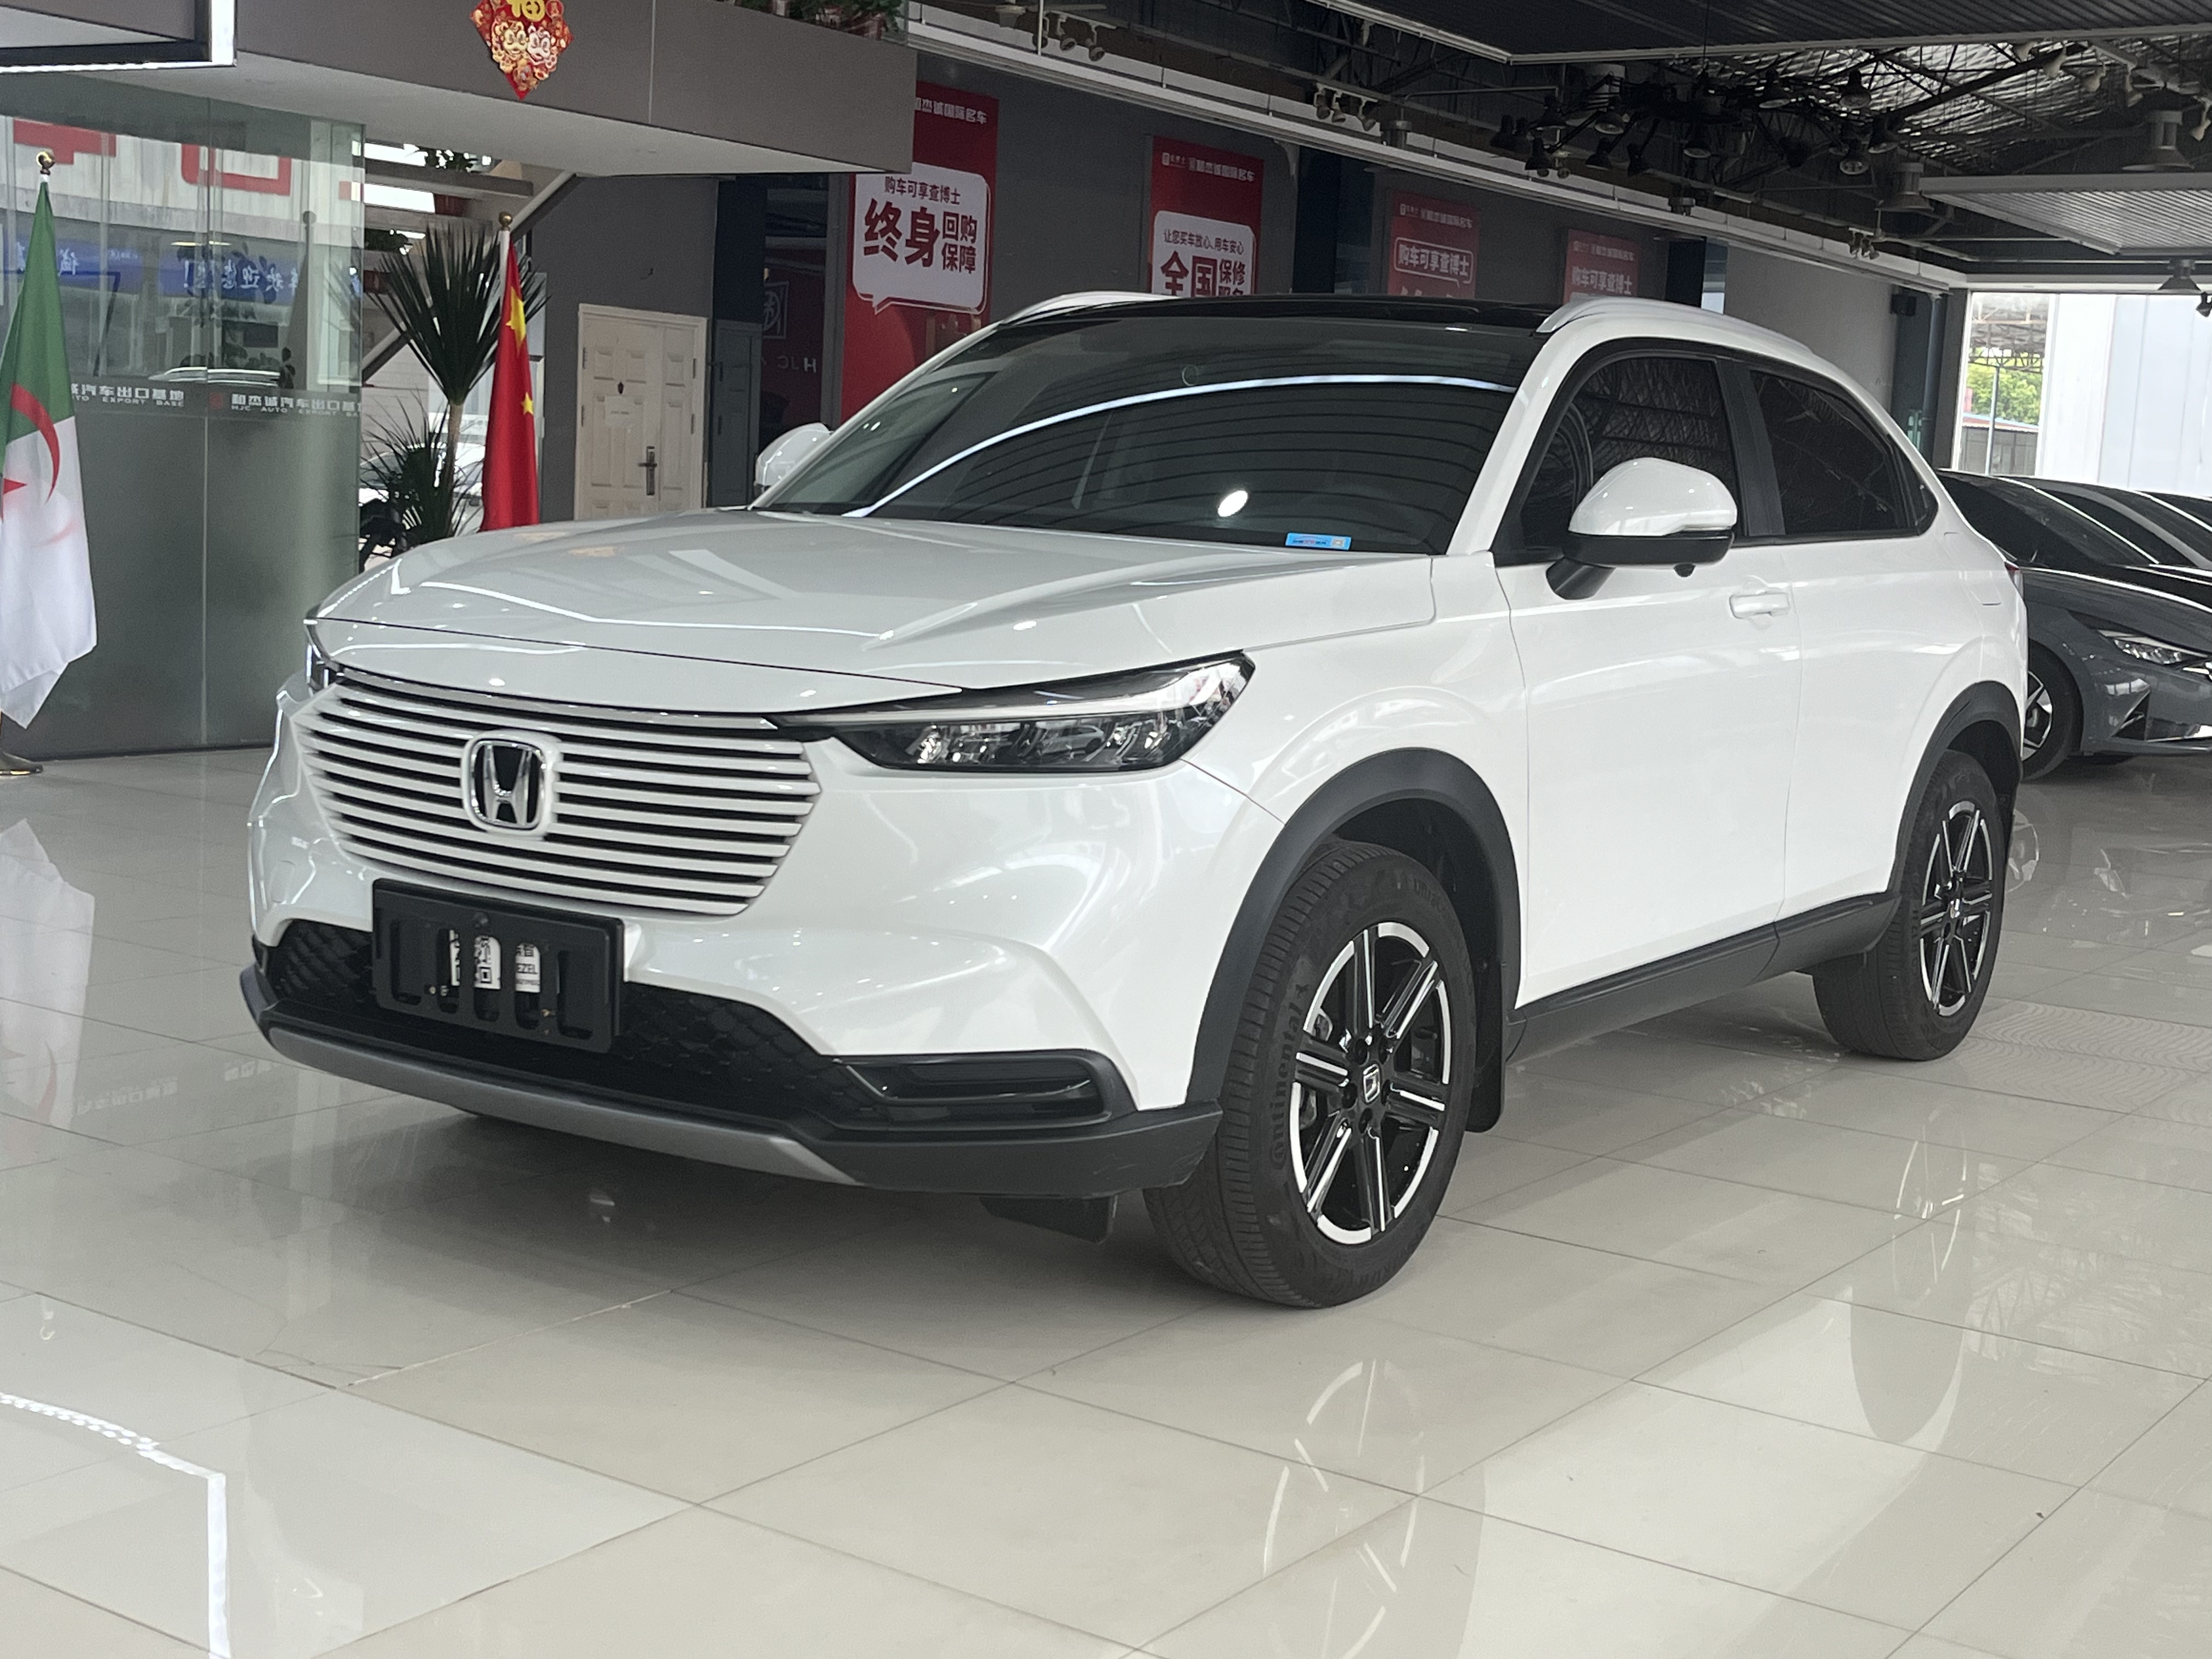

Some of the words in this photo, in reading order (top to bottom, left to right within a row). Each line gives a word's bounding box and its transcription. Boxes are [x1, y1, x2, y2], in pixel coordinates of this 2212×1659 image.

[884, 176, 961, 205] 购车可享查博士
[864, 198, 940, 268] 终身
[942, 211, 978, 244] 回购
[941, 242, 977, 274] 保障
[1160, 250, 1217, 298] 全国
[1219, 258, 1246, 286] 保修
[1398, 244, 1470, 277] 购车可享查博士
[102, 397, 146, 405] EXPORT
